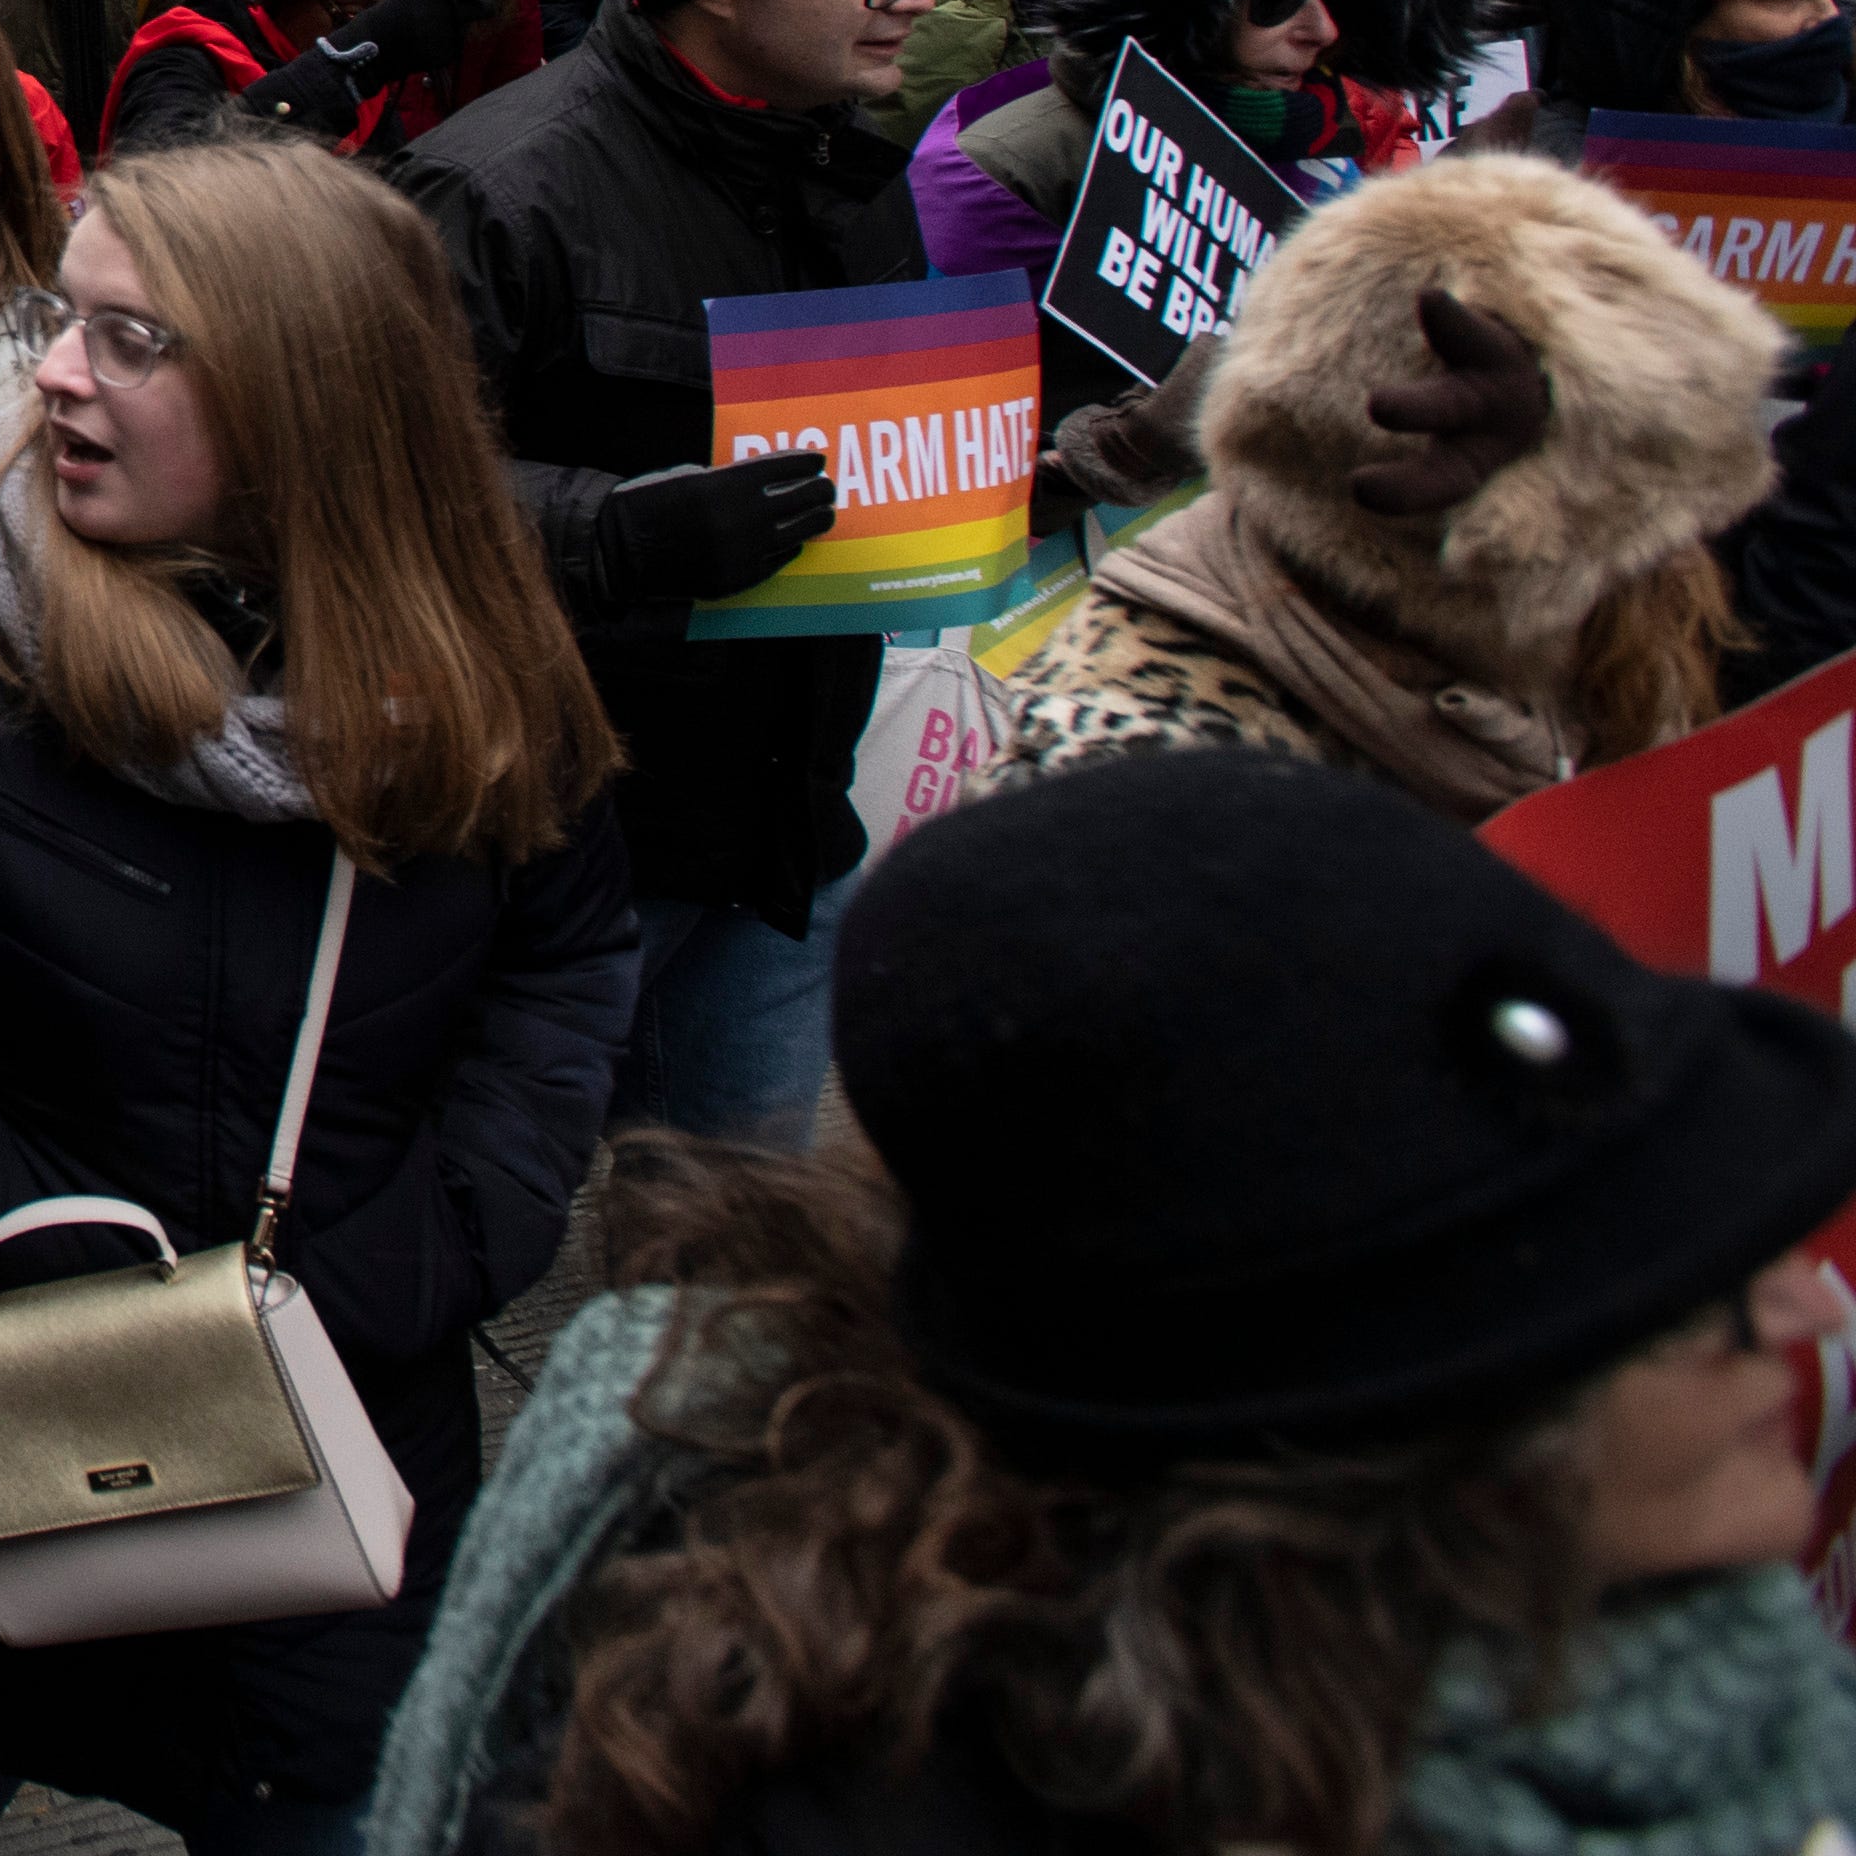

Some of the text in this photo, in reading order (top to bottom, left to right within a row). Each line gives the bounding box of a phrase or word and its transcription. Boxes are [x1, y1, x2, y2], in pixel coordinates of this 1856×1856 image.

[1103, 98, 1185, 197] OUR
[1097, 225, 1158, 312] BE
[1140, 188, 1222, 304] WILL
[954, 396, 1036, 499] HATE
